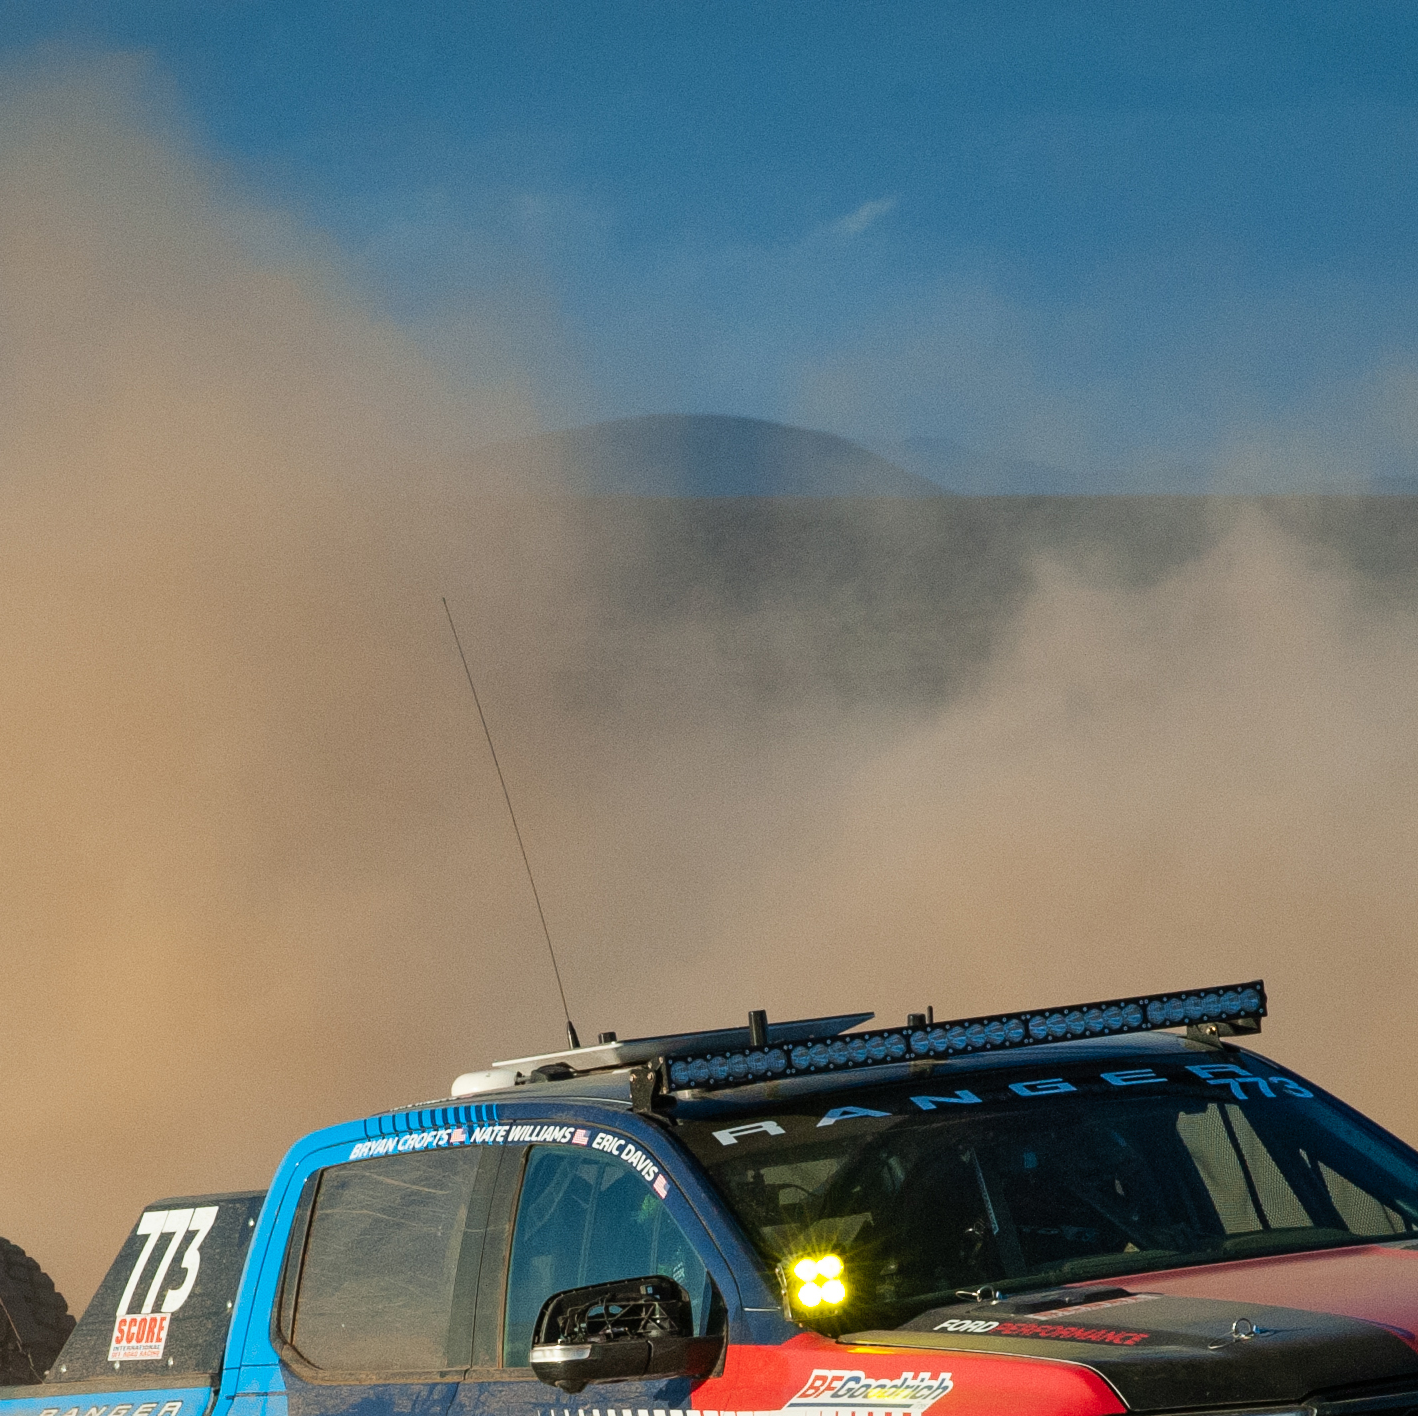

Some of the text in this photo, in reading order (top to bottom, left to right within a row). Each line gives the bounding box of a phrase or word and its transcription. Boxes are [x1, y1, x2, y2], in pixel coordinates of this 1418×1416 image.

[1206, 1077, 1314, 1100] 773
[712, 1064, 1252, 1145] RANGER
[349, 1128, 450, 1160] BRYAN CROFTS
[470, 1125, 575, 1144] NATE WILLIAMS
[591, 1132, 658, 1181] ERIC DAVIS
[116, 1206, 219, 1316] 773
[115, 1316, 167, 1344] SCORE
[933, 1319, 1149, 1345] FORD PERFORMANCE
[796, 1374, 950, 1400] BFGoodrich
